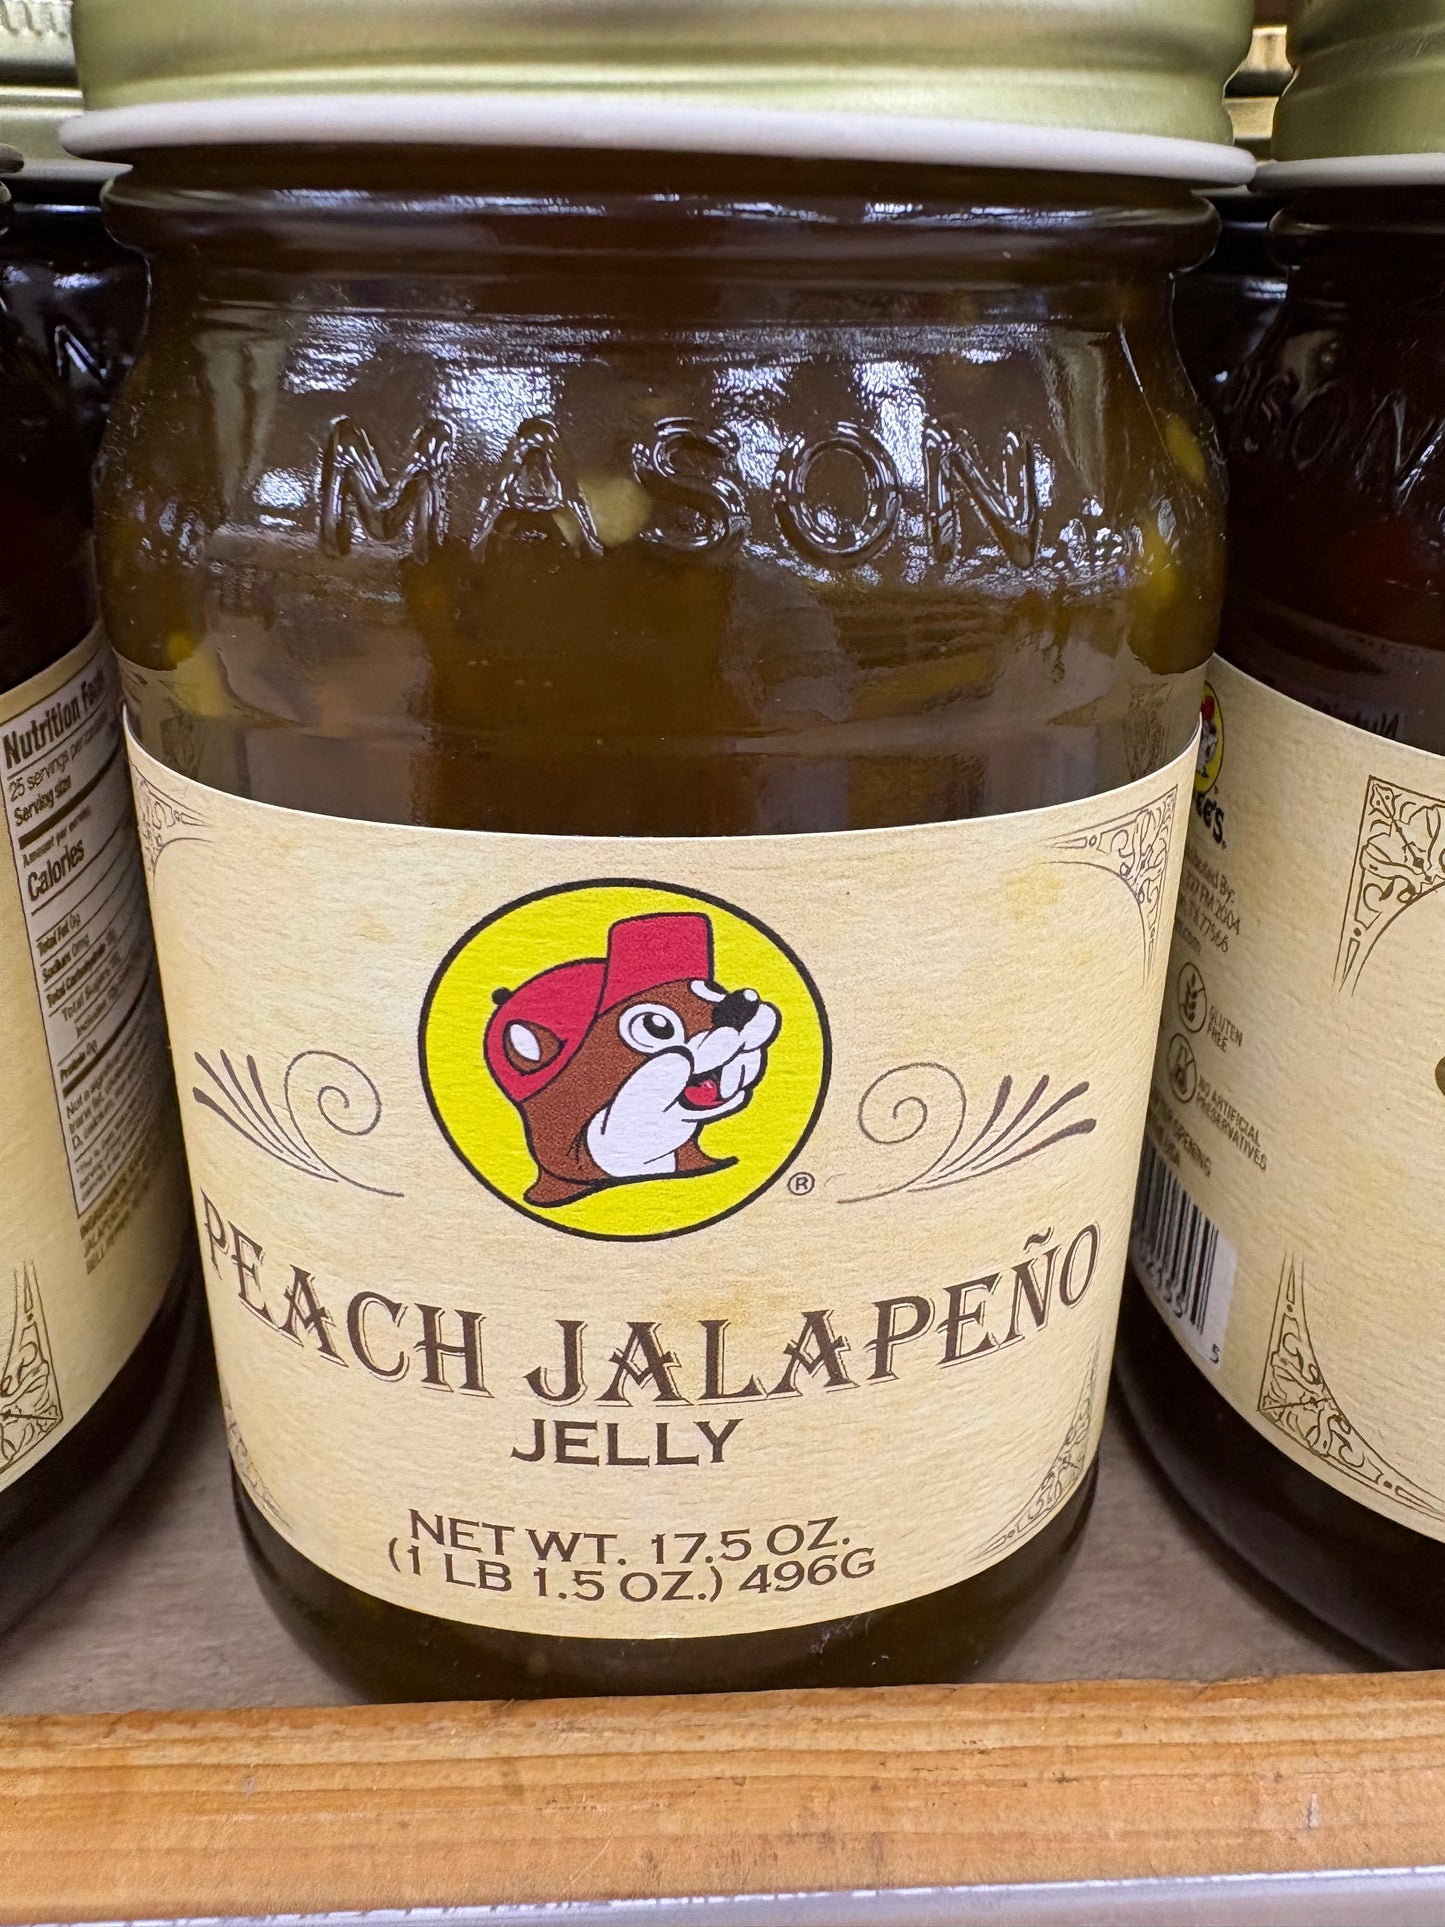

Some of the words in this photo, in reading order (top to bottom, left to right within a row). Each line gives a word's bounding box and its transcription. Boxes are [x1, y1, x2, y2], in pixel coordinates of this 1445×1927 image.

[315, 412, 1046, 570] MASON
[4, 695, 81, 770] Nutrition
[13, 788, 55, 827] Serving
[27, 838, 85, 901] Calories
[1209, 1005, 1244, 1048] GLUTEN
[1210, 1089, 1262, 1149] ARTIFICIAL
[200, 1187, 496, 1399] PEACH
[522, 1221, 1101, 1408] JALAPEÑO
[510, 1418, 744, 1467] JELLY
[408, 1508, 516, 1557] NET
[524, 1526, 627, 1567] WT.
[650, 1527, 753, 1566] 17.5
[765, 1515, 852, 1557] OZ.
[388, 1536, 422, 1576] (1
[444, 1552, 513, 1593] LB
[533, 1565, 606, 1602] 1.5
[619, 1565, 724, 1603] OZ.)
[738, 1546, 877, 1594] 496G
